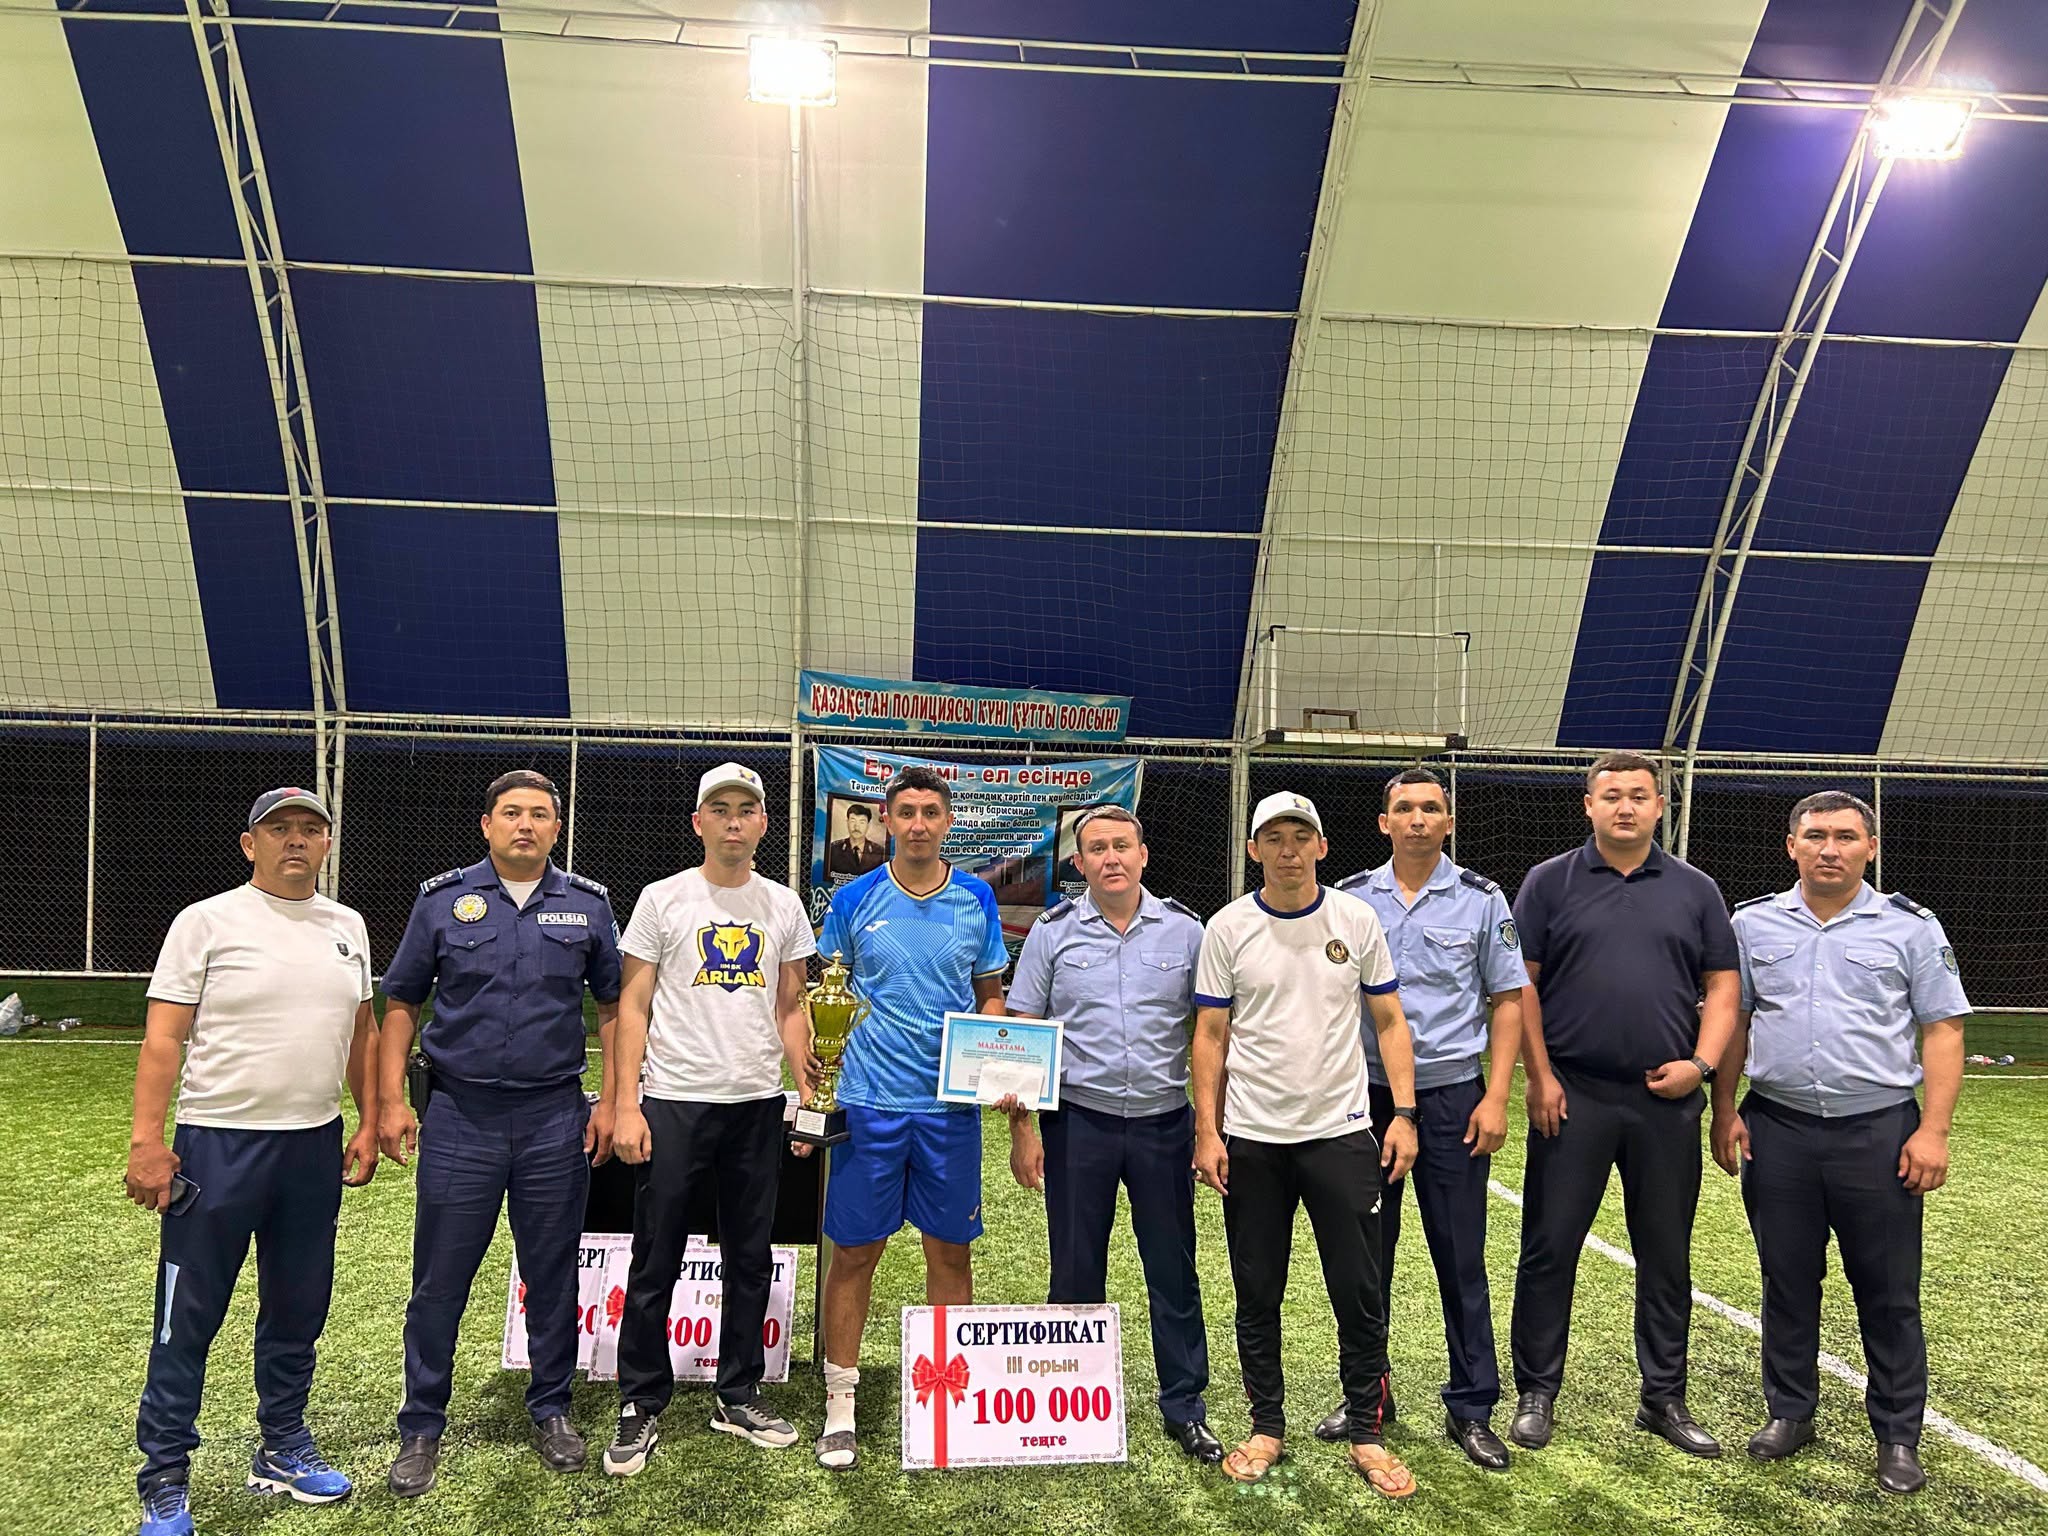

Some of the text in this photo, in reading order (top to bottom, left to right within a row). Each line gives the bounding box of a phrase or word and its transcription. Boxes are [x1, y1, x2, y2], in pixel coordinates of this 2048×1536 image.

[811, 684, 1120, 732] ҚАЗАҚСТАН ПОЛИЦИЯСЫ КҮНІ ҚҰТТЫ БОЛСЫН!
[865, 758, 894, 781] Ер
[983, 768, 1009, 783] ел
[1018, 766, 1092, 788] есінде
[1032, 793, 1047, 803] пен
[970, 806, 985, 816] ету
[982, 847, 998, 856] алу
[541, 913, 585, 923] POLISIA
[693, 968, 766, 988] ARLAN
[956, 1320, 1107, 1346] СЕРТИФИКАТ
[1027, 1358, 1079, 1377] орын
[972, 1385, 1112, 1425] 100 000
[1019, 1434, 1068, 1449] теңге
